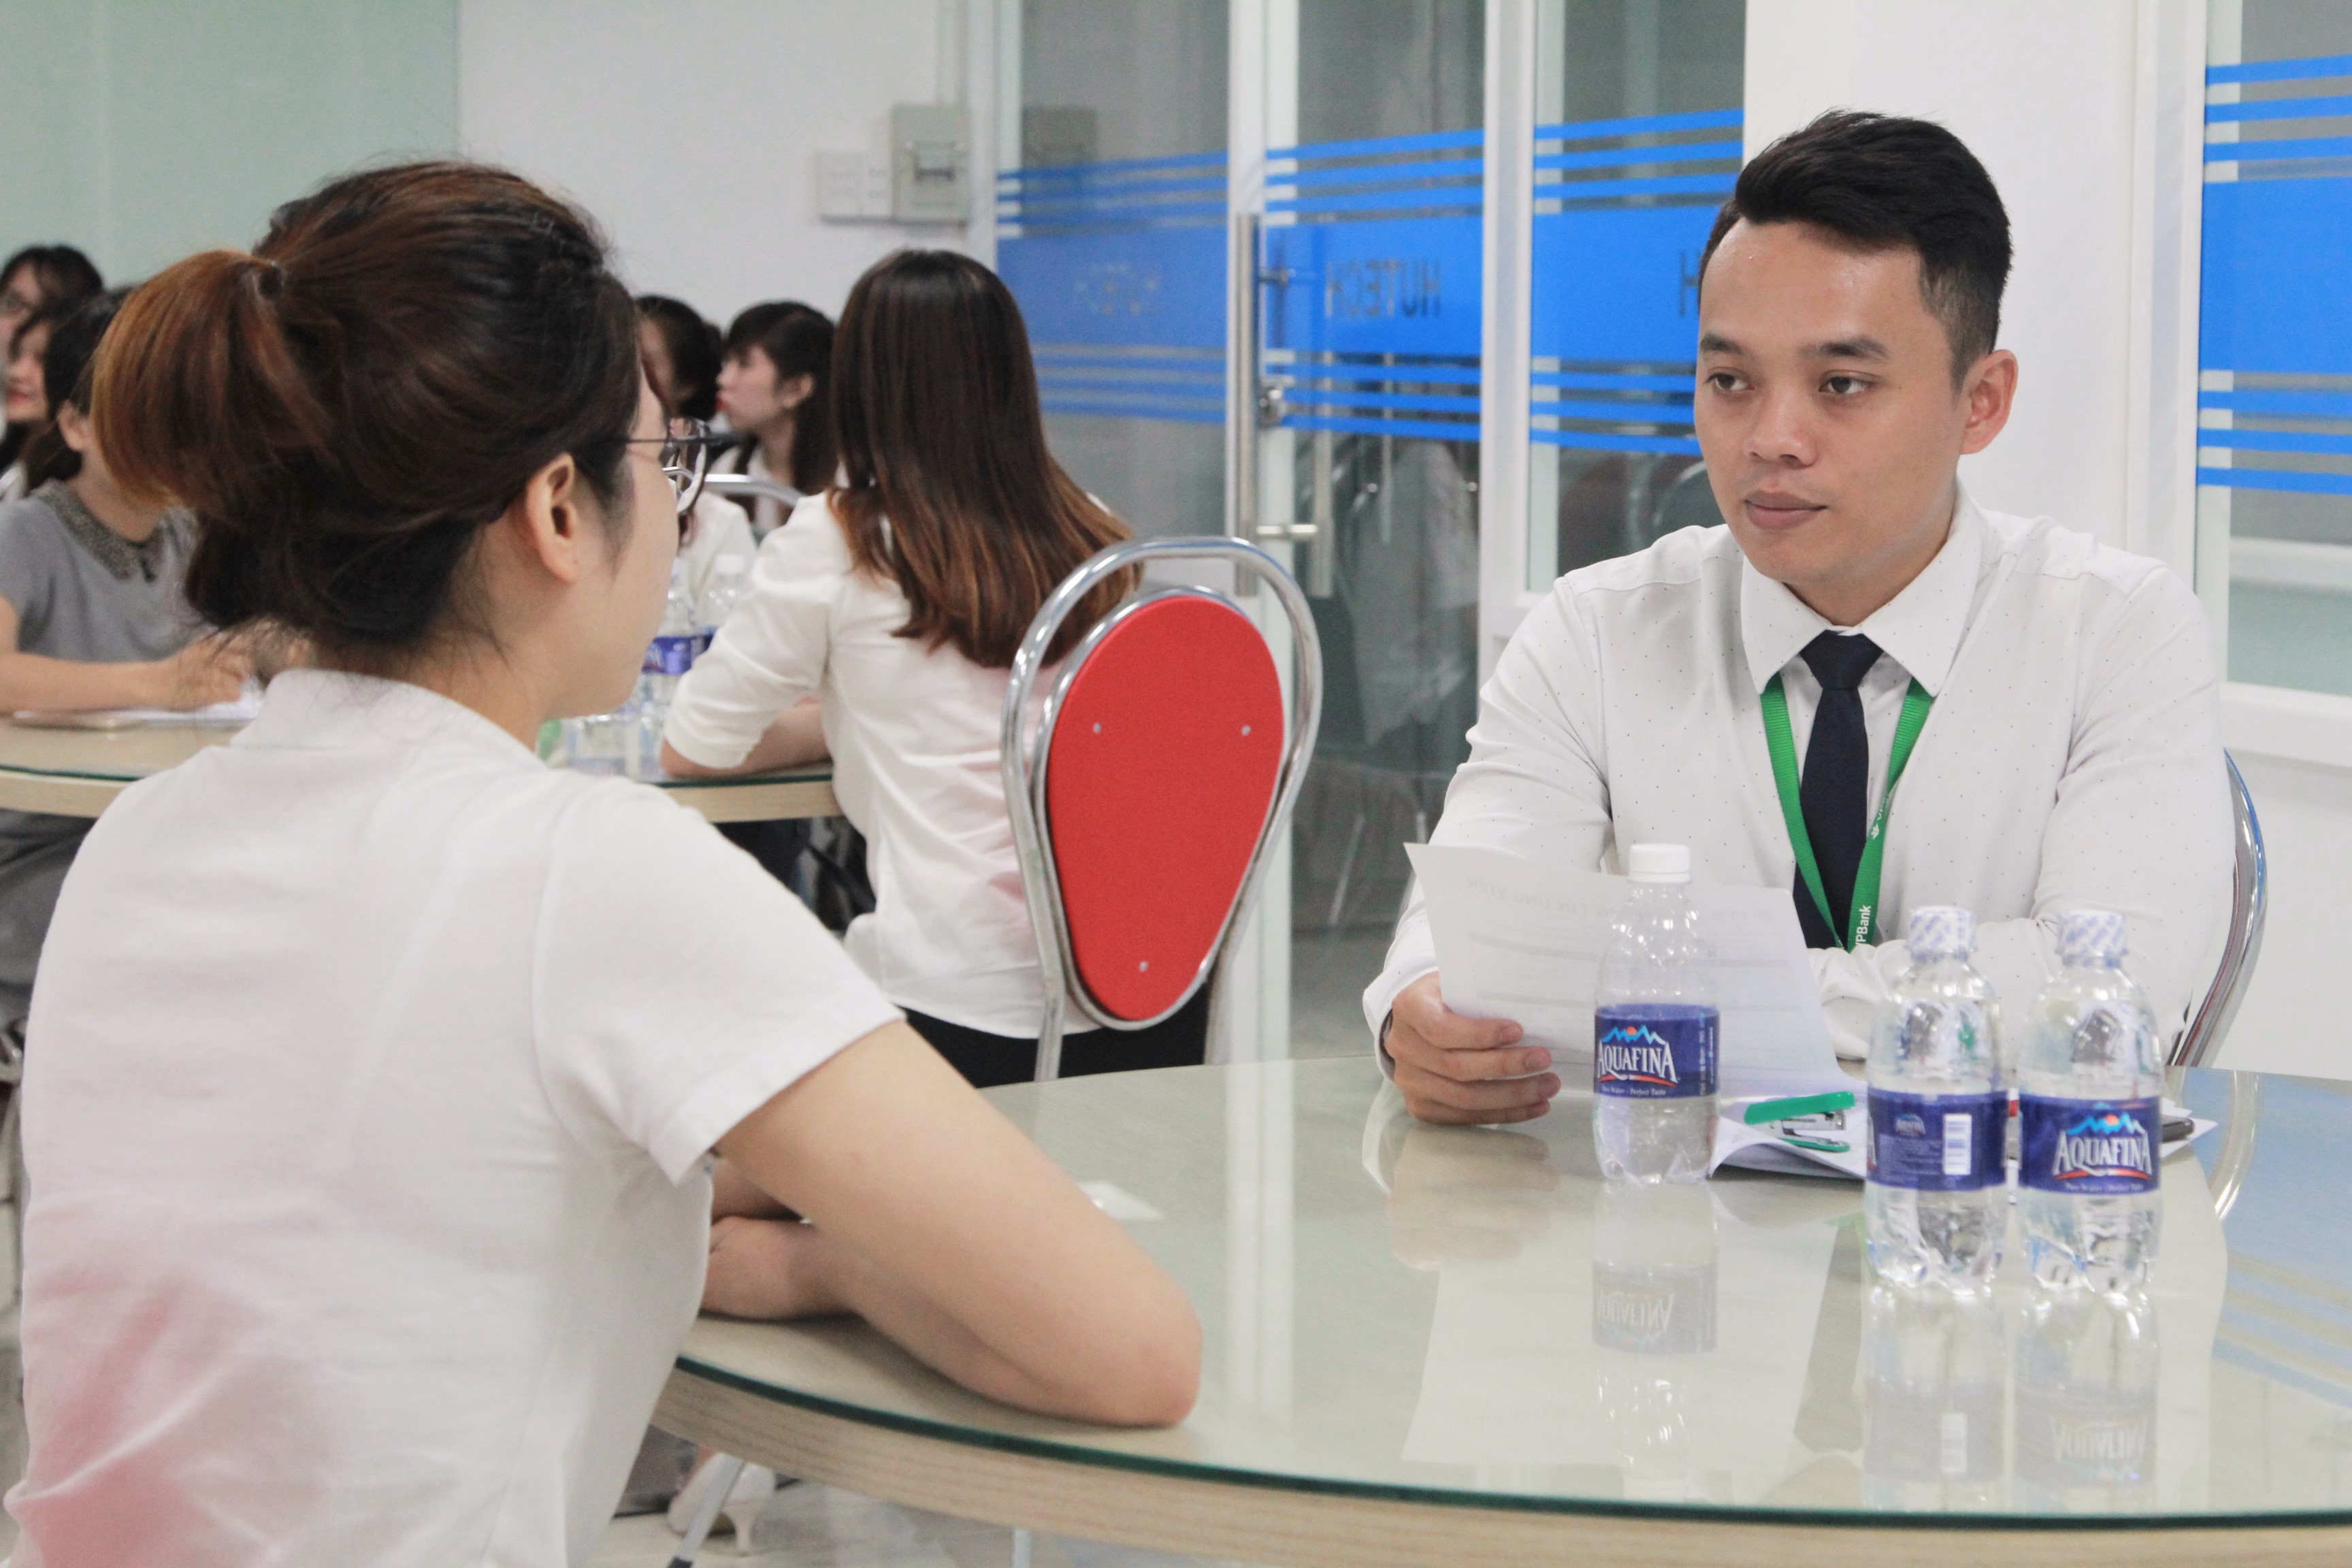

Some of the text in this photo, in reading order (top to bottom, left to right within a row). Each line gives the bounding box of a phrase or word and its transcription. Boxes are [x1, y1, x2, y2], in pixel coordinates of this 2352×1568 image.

[1855, 904, 1872, 945] PBank
[1597, 1039, 1678, 1083] AQUAFINA
[2051, 1130, 2153, 1177] AQUAFINA
